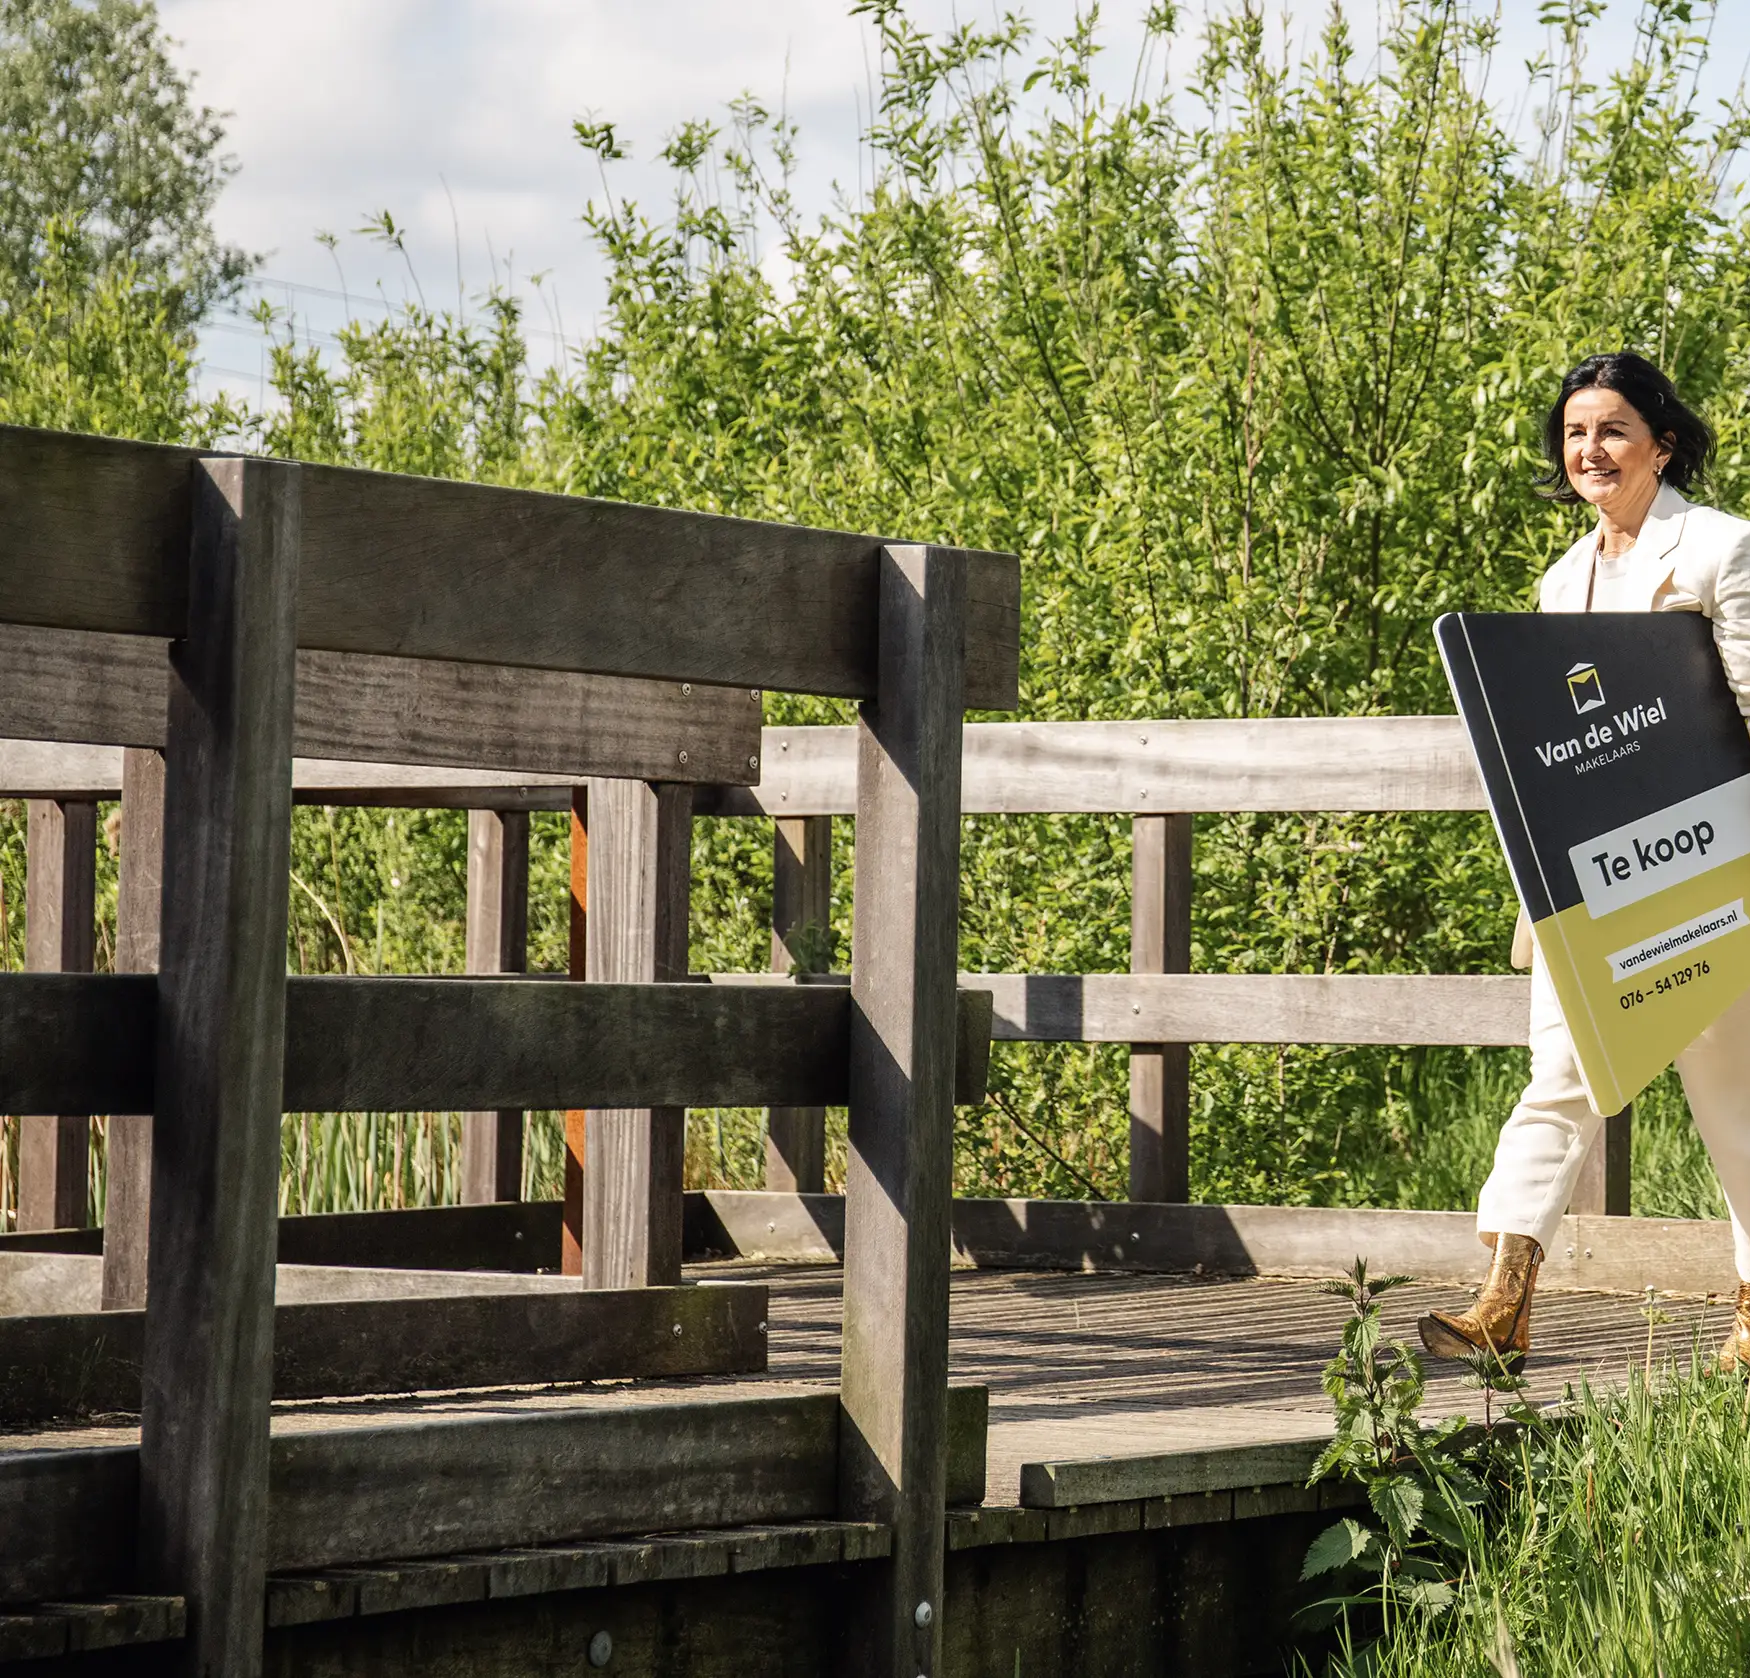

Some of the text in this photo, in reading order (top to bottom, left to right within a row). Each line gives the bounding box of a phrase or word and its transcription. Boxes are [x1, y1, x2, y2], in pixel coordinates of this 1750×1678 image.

[1534, 696, 1667, 768] Van de Wiel
[1574, 740, 1641, 775] MAKELAARS
[1591, 820, 1715, 887] Te koop
[1619, 909, 1738, 970] vandewielmakelaars.nl
[1620, 989, 1644, 1010] 076
[1655, 976, 1672, 994] 54
[1671, 967, 1693, 987] 129
[1693, 960, 1710, 977] 76
